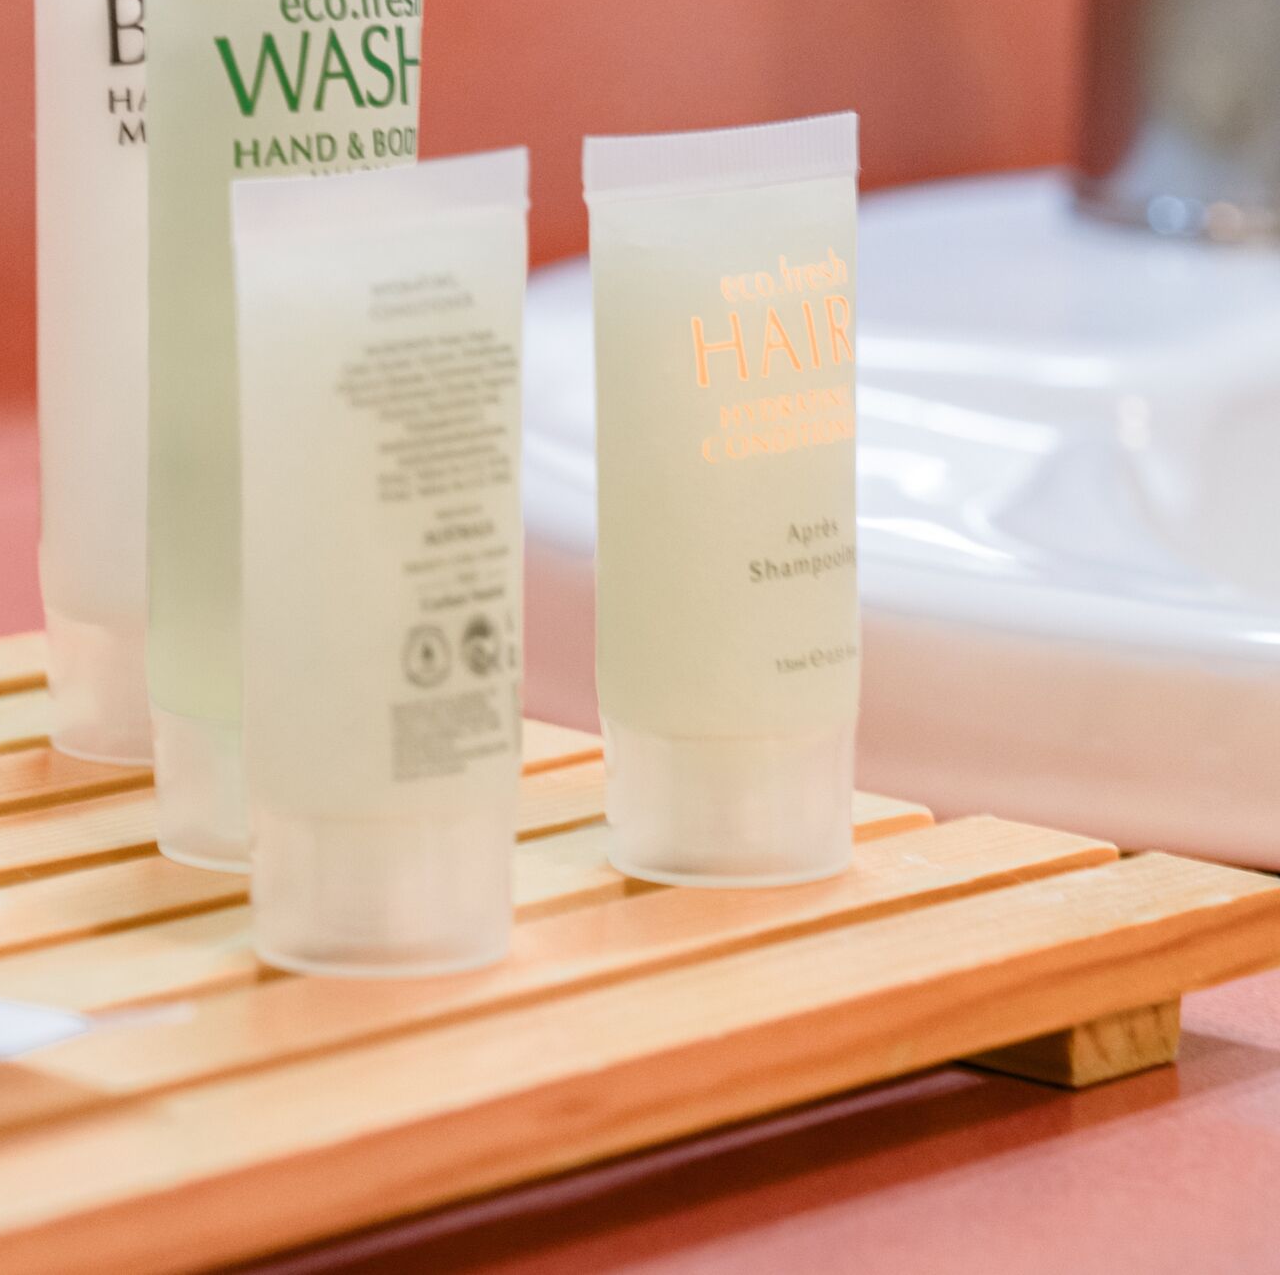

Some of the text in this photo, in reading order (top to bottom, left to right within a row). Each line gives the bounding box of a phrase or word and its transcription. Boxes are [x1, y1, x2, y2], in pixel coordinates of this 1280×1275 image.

[215, 24, 421, 117] WASH
[234, 132, 338, 169] HAND
[347, 131, 365, 161] &
[720, 246, 848, 303] eco.fresh
[691, 295, 855, 388] HAIR
